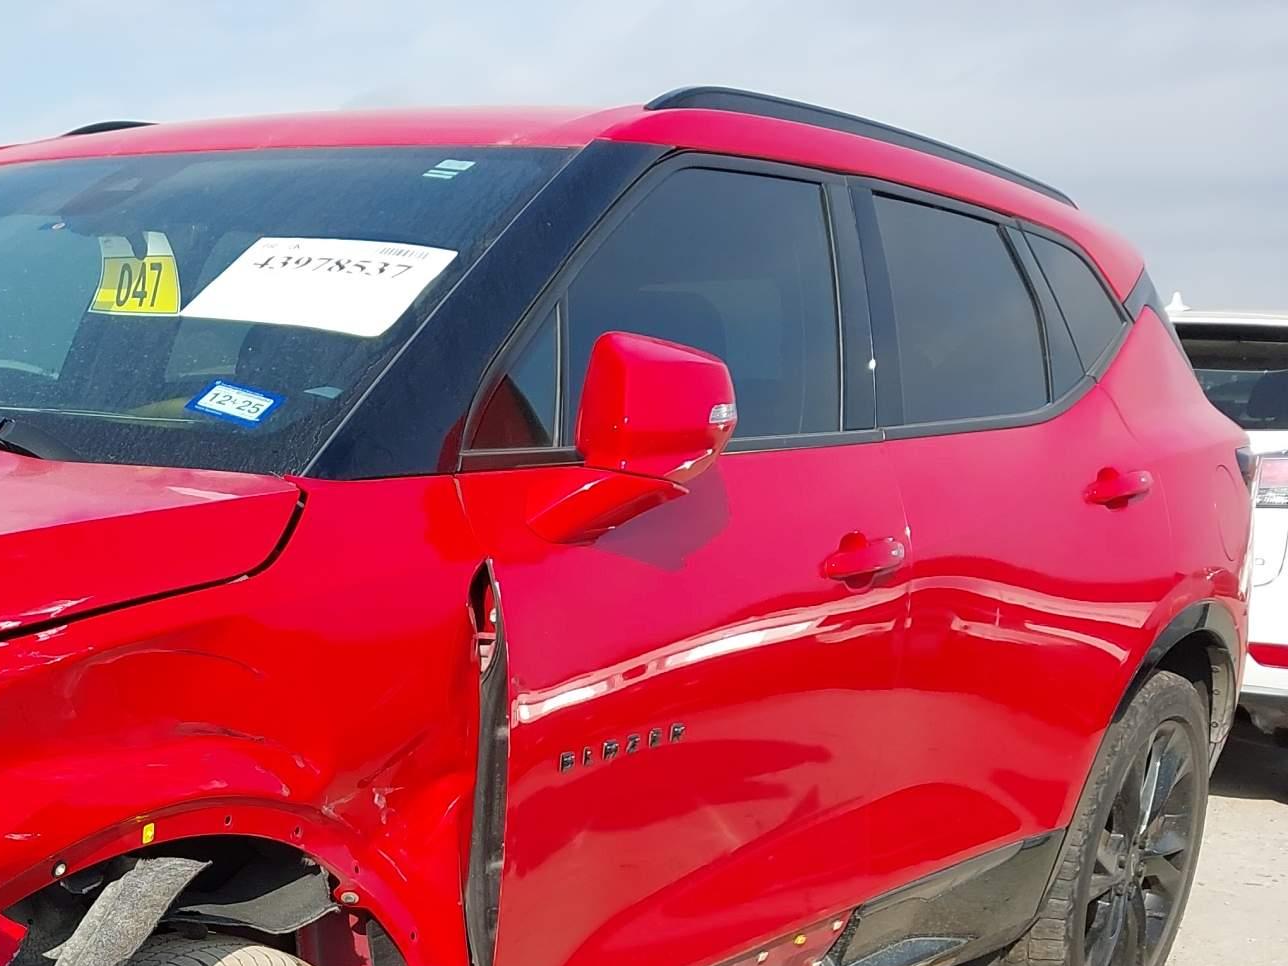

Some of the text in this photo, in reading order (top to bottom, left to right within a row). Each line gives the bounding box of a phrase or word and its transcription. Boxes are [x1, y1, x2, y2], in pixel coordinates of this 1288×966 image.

[116, 262, 162, 307] 047
[253, 255, 413, 279] 43978537
[559, 723, 686, 772] BLAZER
